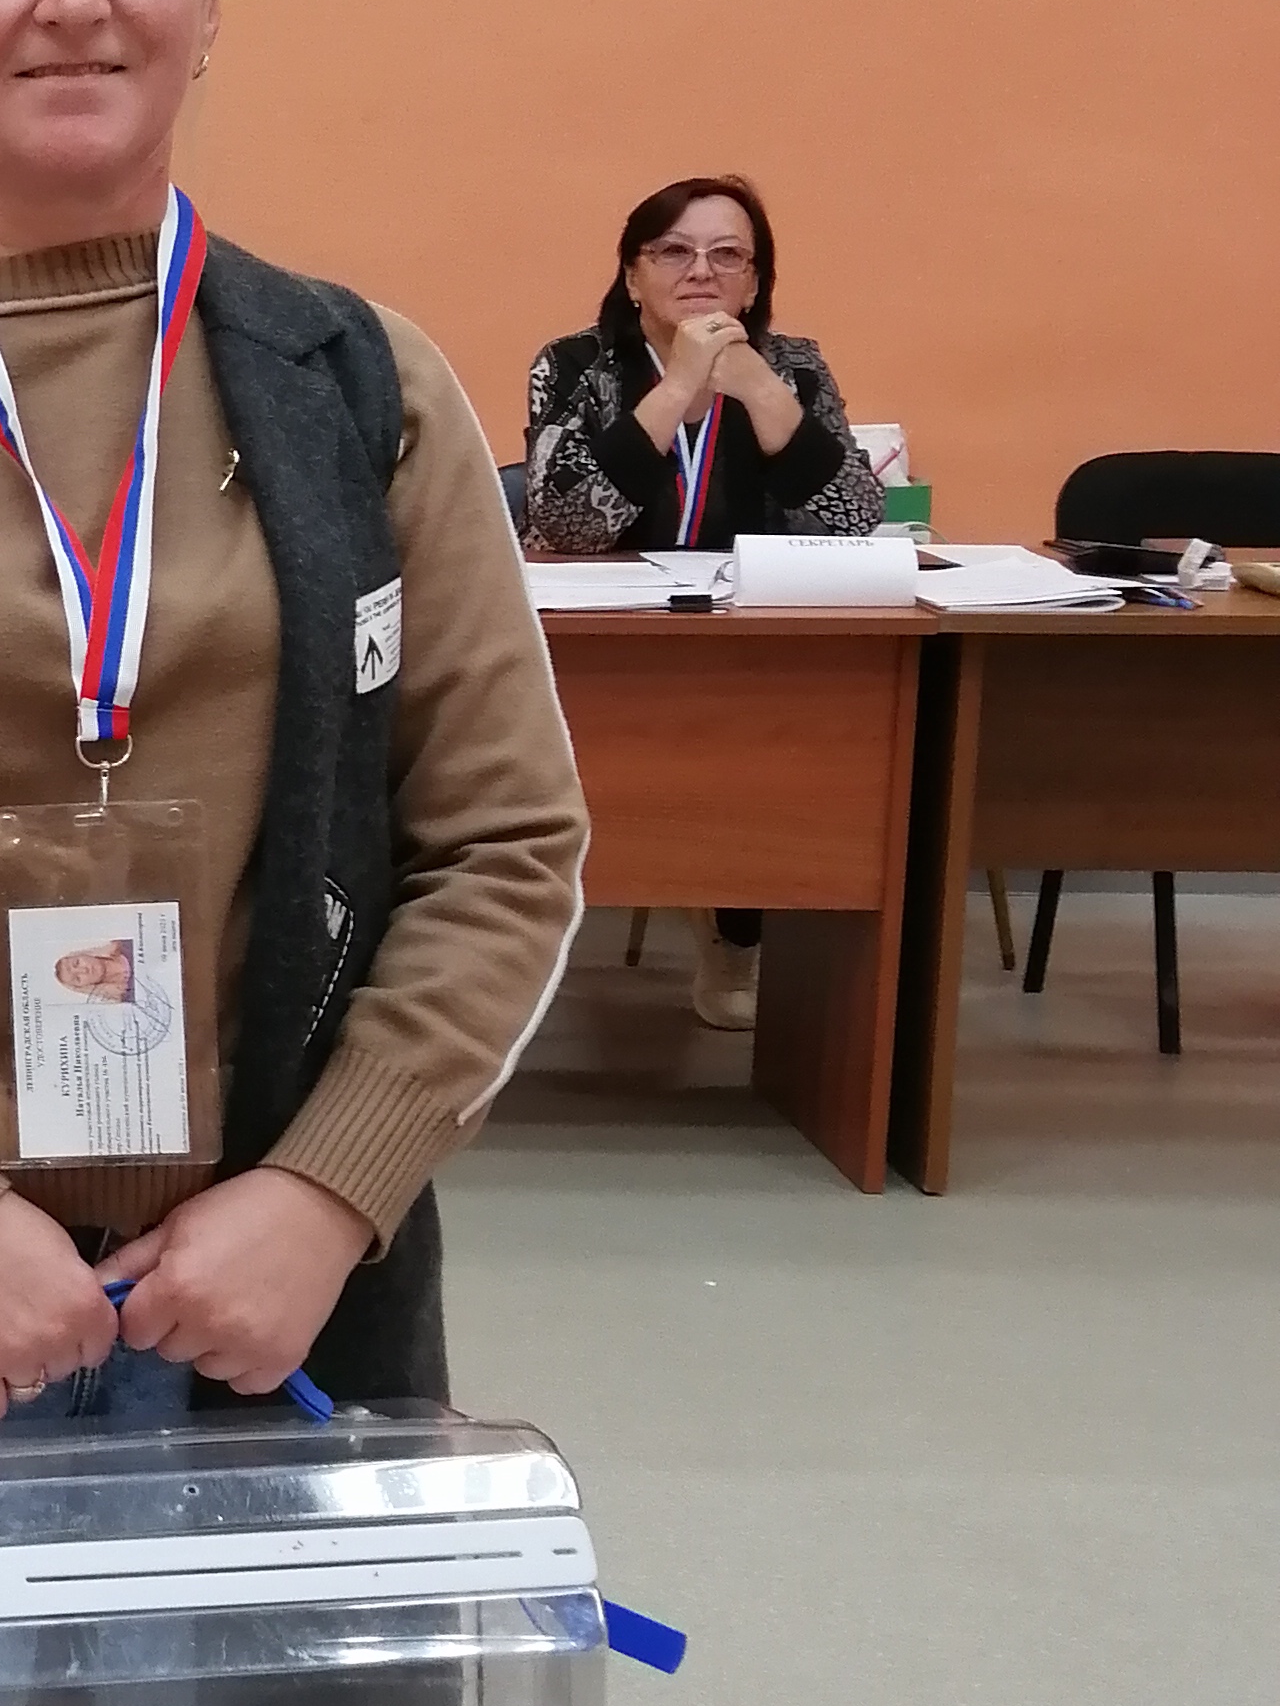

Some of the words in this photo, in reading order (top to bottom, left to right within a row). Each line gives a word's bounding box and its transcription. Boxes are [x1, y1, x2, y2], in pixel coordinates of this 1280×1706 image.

[788, 538, 874, 547] СЕКРЕТАРЬ
[21, 973, 30, 1014] ОБЛАСТЬ
[23, 1016, 34, 1092] ЛЕНИНГРАДСКАЯ
[59, 1035, 70, 1097] КУРИХИНА
[72, 1014, 83, 1073] Николаевна
[74, 1075, 84, 1117] Наталья
